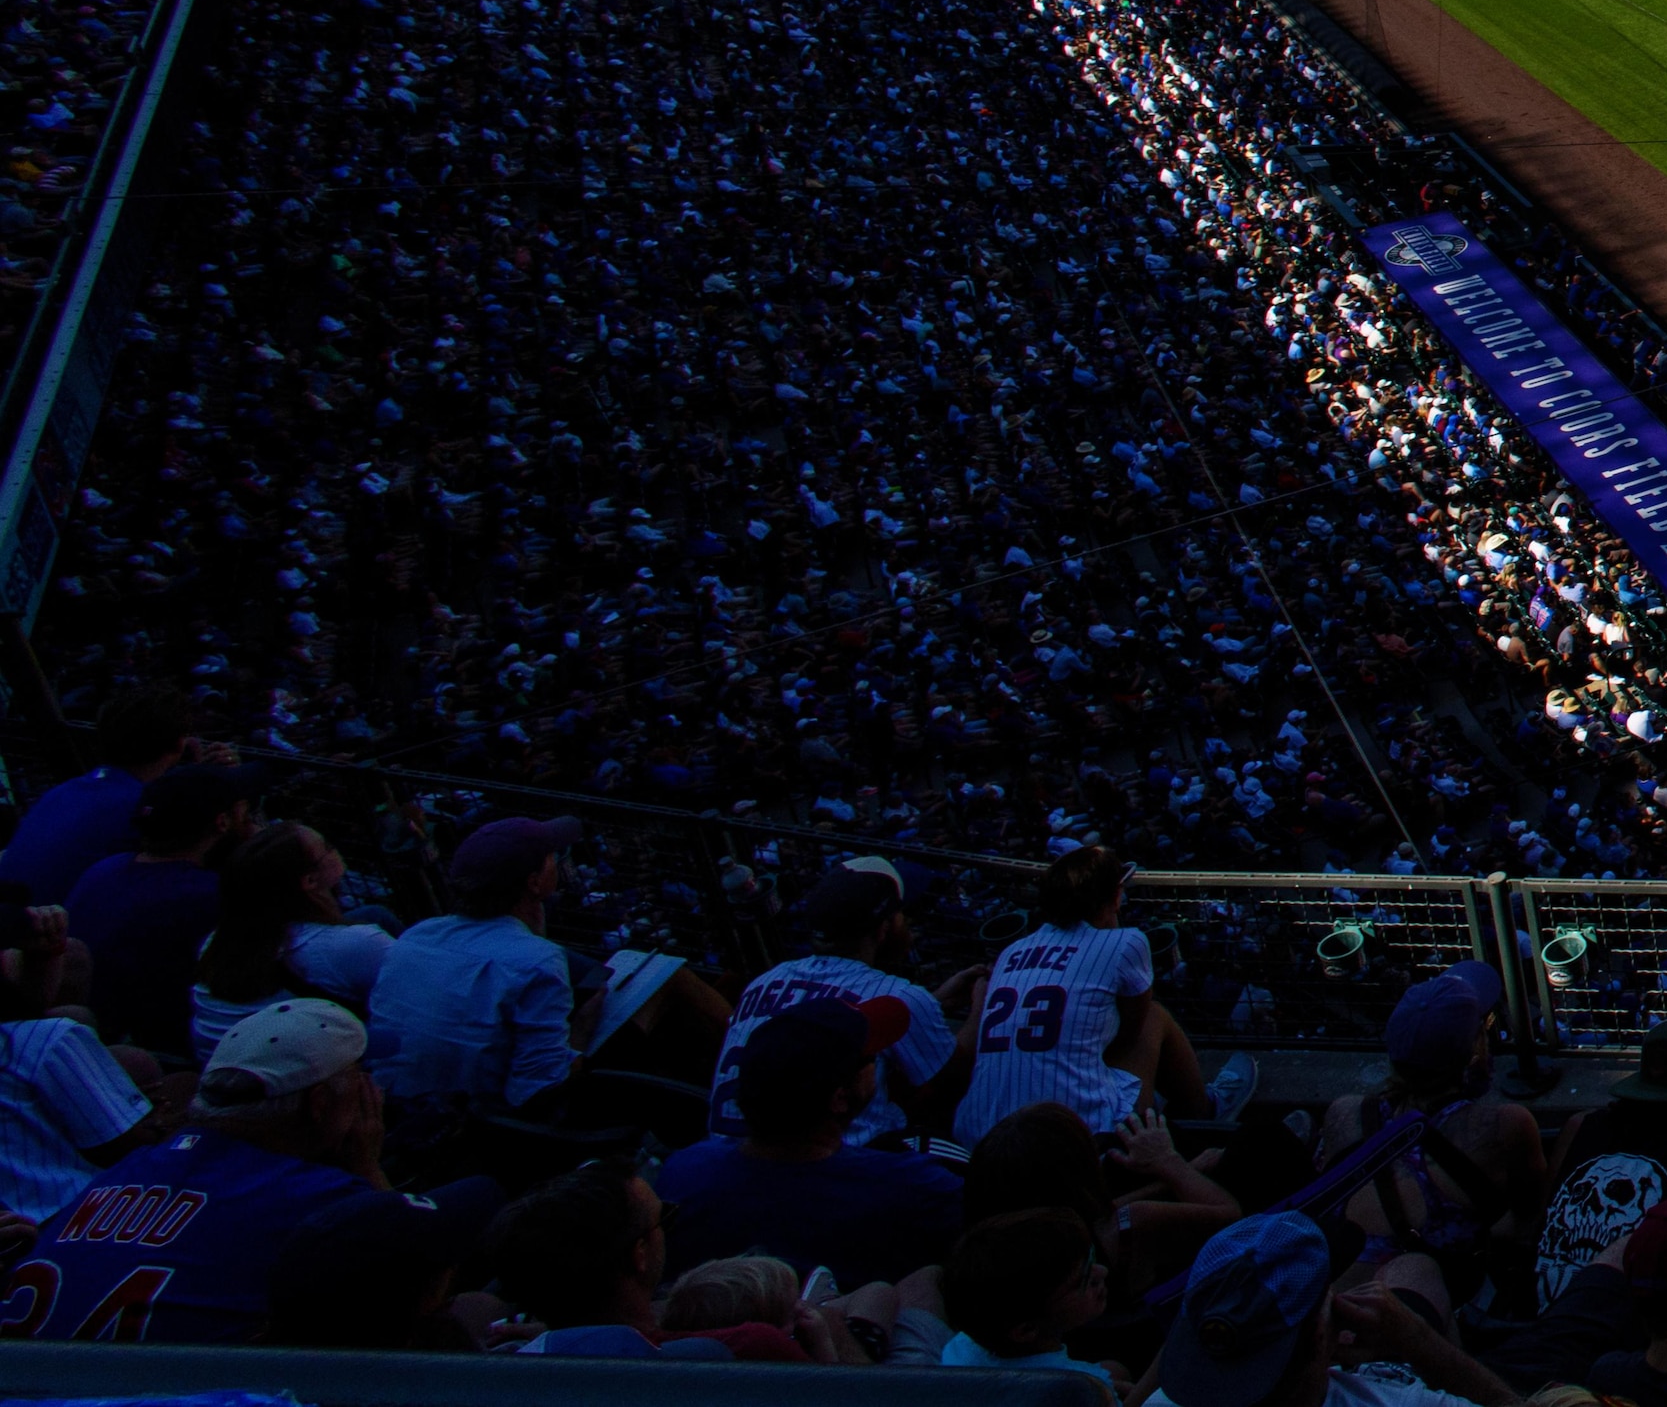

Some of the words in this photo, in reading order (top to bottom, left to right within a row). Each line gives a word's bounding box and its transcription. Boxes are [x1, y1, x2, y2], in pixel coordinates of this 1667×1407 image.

[1433, 274, 1545, 359] WELCOME
[1511, 357, 1574, 389] TO
[1538, 388, 1639, 459] COORS
[1004, 945, 1079, 973] SINCE
[979, 985, 1067, 1053] 23
[57, 1185, 207, 1247] WOOD
